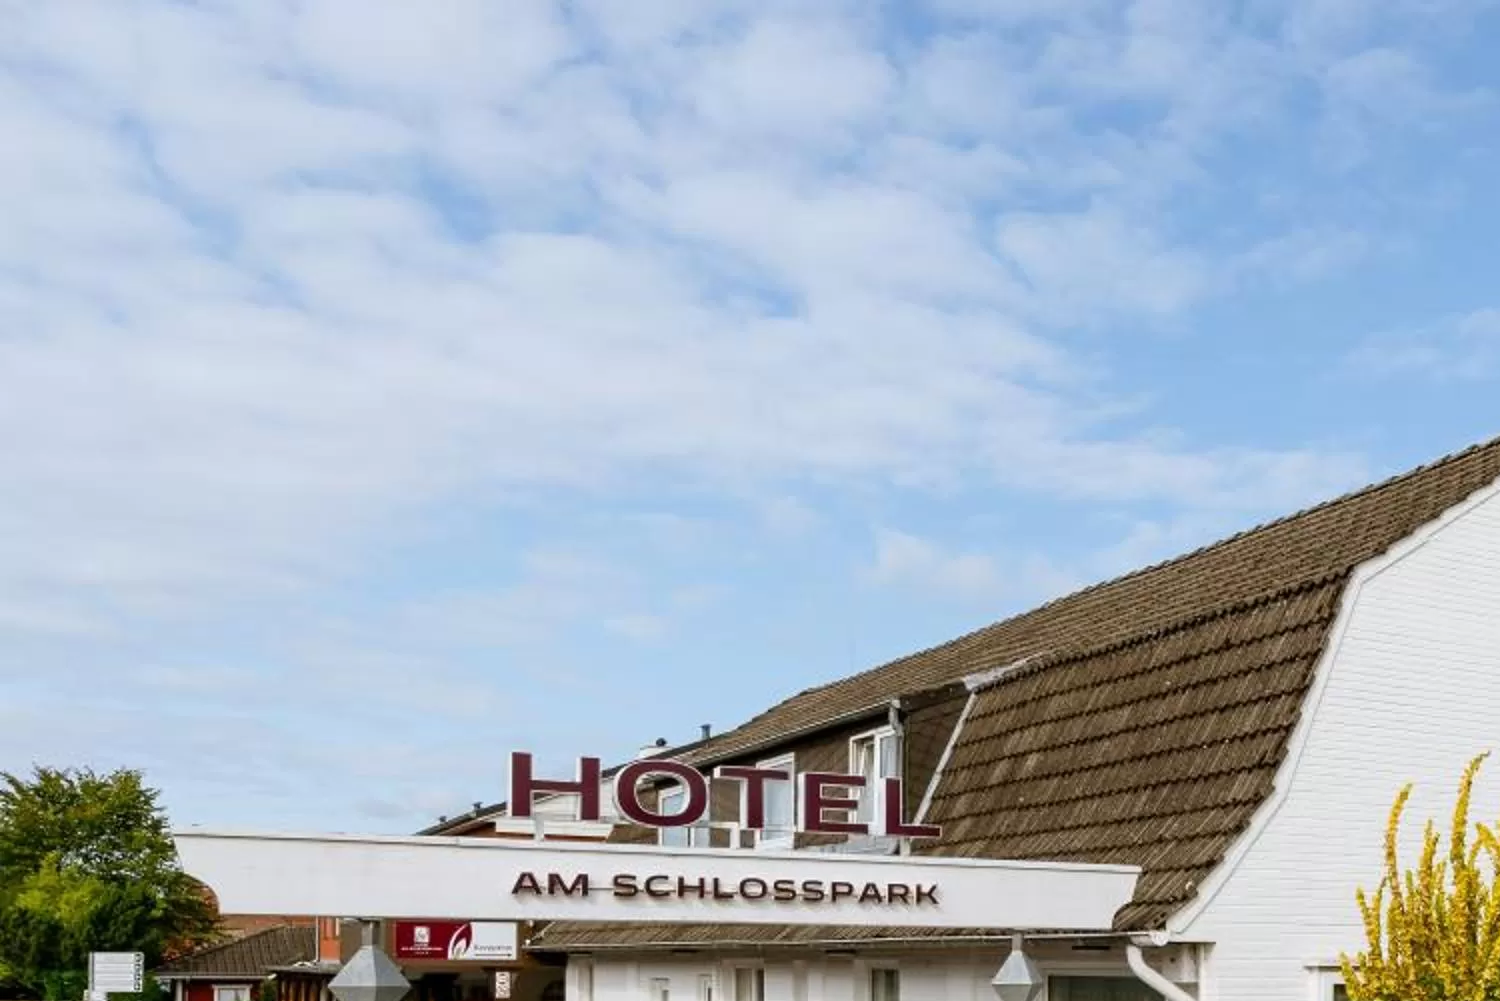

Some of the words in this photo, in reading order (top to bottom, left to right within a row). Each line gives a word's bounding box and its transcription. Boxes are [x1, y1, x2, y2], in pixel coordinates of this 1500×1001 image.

[508, 751, 943, 839] HOTEL
[512, 872, 590, 897] AM
[613, 874, 940, 905] SCHLOSSPARK
